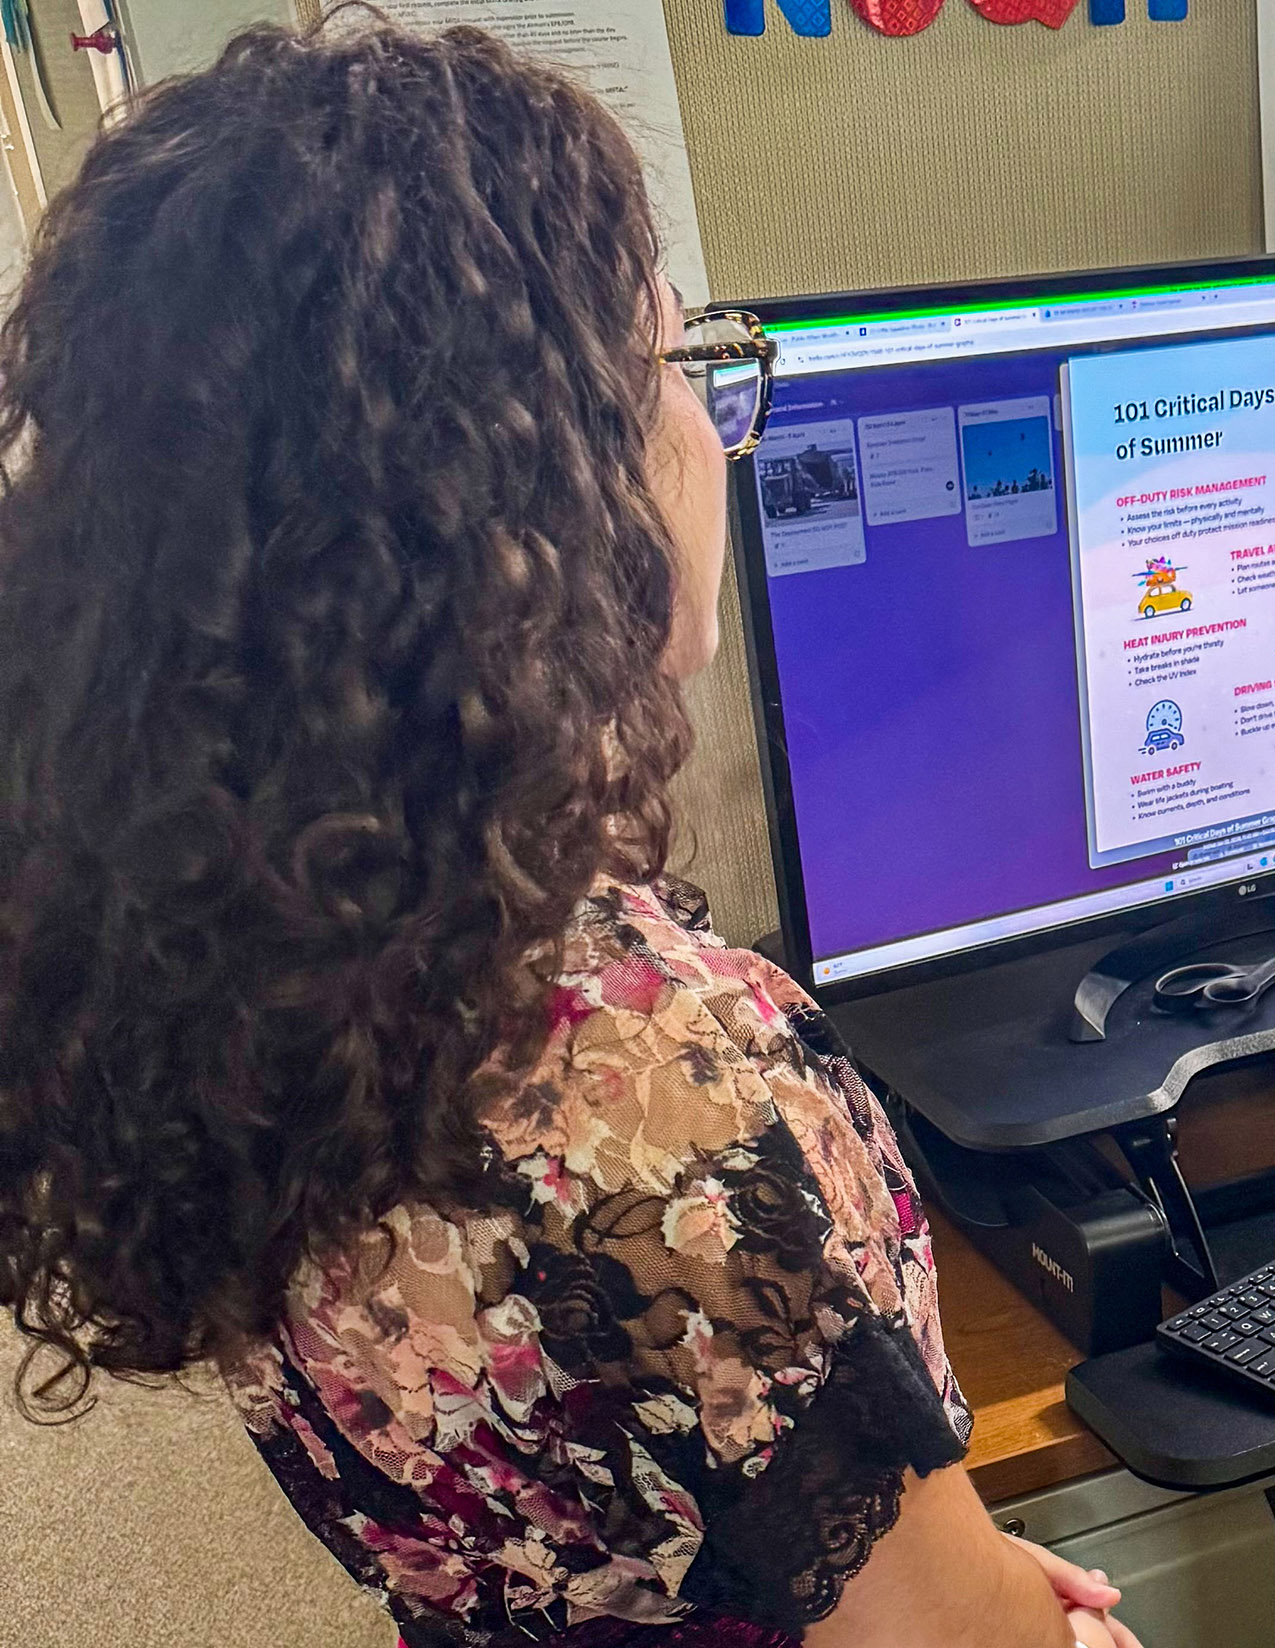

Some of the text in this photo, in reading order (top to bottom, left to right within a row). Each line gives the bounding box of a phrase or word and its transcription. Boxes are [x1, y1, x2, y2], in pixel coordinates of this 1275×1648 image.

[1114, 387, 1275, 424] 101 Critical Days
[1116, 430, 1223, 460] of Summer
[1116, 476, 1266, 507] OFF-DUTY RISK MANAGEMENT
[1126, 496, 1242, 522] Assess the risk before every activity
[1127, 525, 1146, 534] Know
[1147, 523, 1162, 533] your
[1163, 519, 1181, 528] limits
[1190, 512, 1222, 525] physically
[1224, 510, 1235, 518] and
[1236, 505, 1264, 517] mentally
[1128, 538, 1143, 547] Your
[1144, 534, 1169, 544] choices
[1171, 532, 1180, 540] off
[1182, 529, 1196, 539] duty
[1197, 525, 1222, 536] protect
[1223, 521, 1247, 530] mission
[1230, 546, 1264, 559] TRAVEL
[1124, 619, 1246, 649] HEAT INJURY PREVENTION
[1133, 651, 1159, 664] Hydrate
[1160, 647, 1181, 657] before
[1203, 638, 1224, 650] thirsty
[1134, 665, 1149, 674] Take
[1150, 660, 1172, 670] breaks
[1181, 655, 1199, 664] shade
[1134, 676, 1155, 686] Check
[1156, 673, 1167, 681] the
[1168, 671, 1178, 679] UV
[1234, 681, 1271, 695] DRIVING
[1130, 762, 1201, 784] WATER SAFETY
[1137, 787, 1155, 797] Swim
[1156, 784, 1170, 792] with
[1176, 778, 1196, 789] buddy
[1138, 781, 1233, 808] Wear life jackets during boating
[1138, 810, 1155, 819] Know
[1206, 795, 1217, 803] and
[1218, 788, 1249, 800] conditions
[1247, 883, 1257, 893] LG
